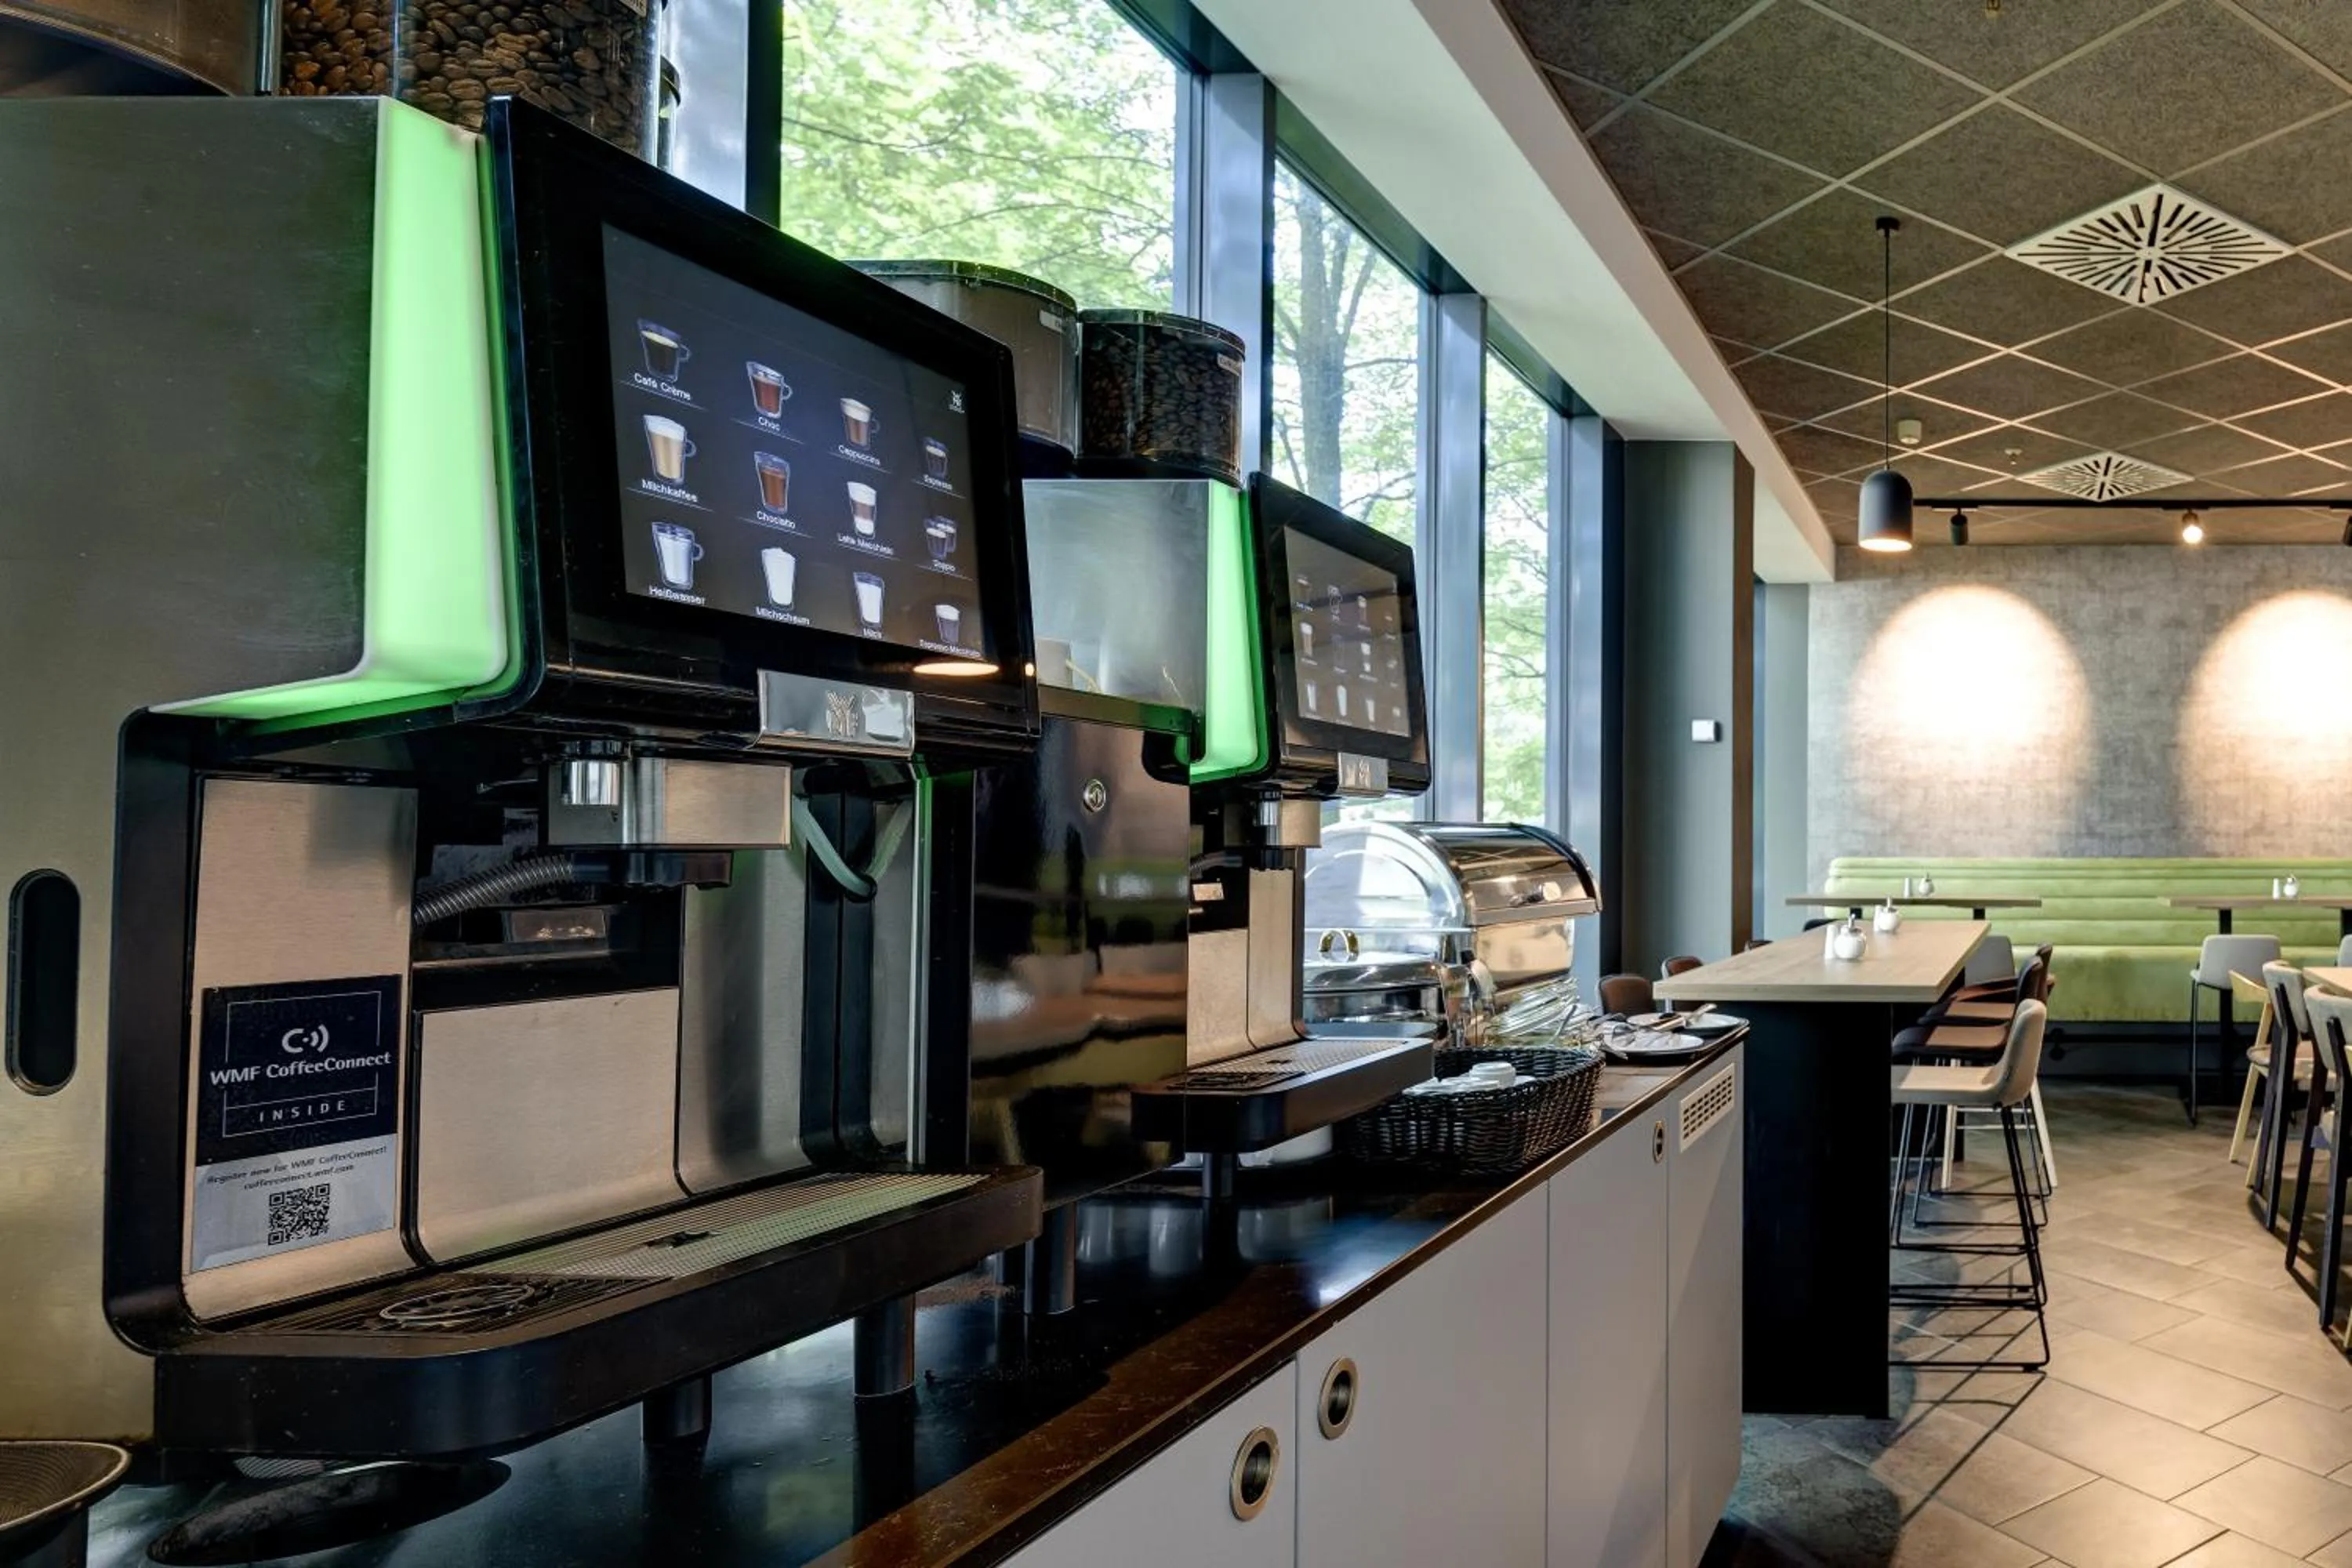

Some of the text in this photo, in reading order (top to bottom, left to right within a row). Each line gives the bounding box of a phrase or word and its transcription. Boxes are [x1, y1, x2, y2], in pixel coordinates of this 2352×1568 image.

[642, 479, 698, 503] Milchkaffee
[209, 1051, 392, 1086] WMF CoffeeConnect
[259, 1100, 346, 1123] INSIDE
[291, 1158, 315, 1169] WMF
